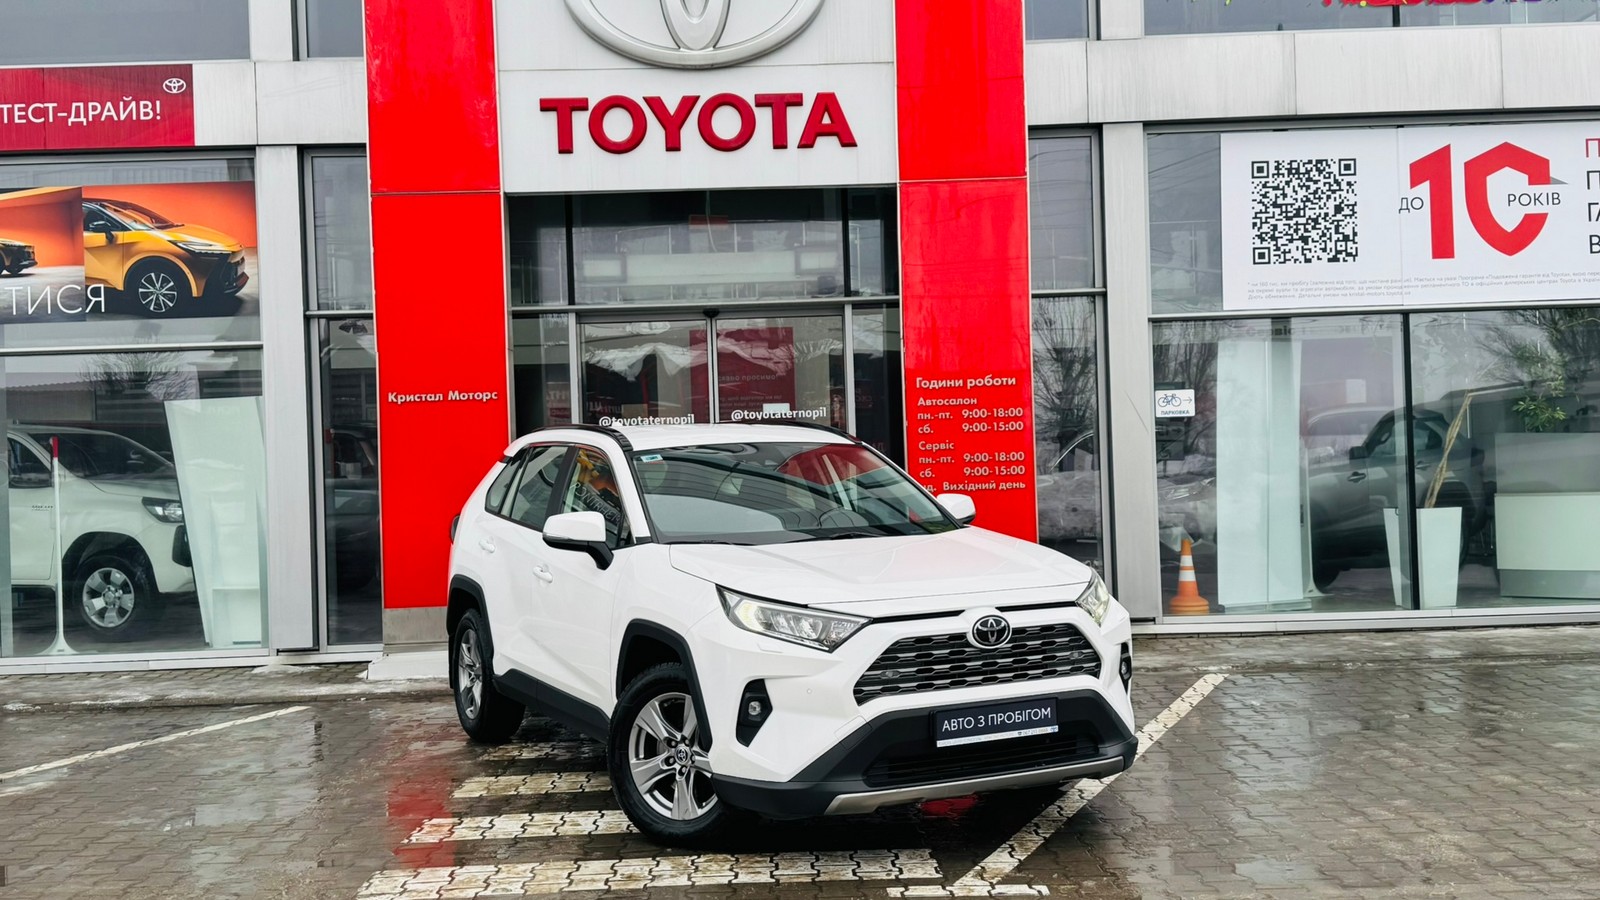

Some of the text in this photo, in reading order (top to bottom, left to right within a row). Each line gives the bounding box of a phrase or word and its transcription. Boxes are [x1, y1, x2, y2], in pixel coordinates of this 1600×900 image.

[0, 97, 162, 126] ТЕСТ-ДРАЙВ!
[539, 92, 858, 154] TOYOTA
[1399, 197, 1424, 214] ДО
[1507, 193, 1561, 207] РОКІВ
[916, 374, 1016, 389] Години роботи
[388, 390, 498, 404] Кристал Моторс
[918, 397, 978, 406] Автосалон
[731, 407, 827, 421] @toyotaternopil
[918, 408, 1024, 420] пн.-пт. 9:00-18:00
[918, 422, 1024, 434] сб. 9:00-15:00
[918, 440, 954, 452] Сервіс
[919, 452, 1025, 464] пн.-пт. 9:00-18:00
[920, 466, 1026, 478] сб. 9:00-15:00
[943, 480, 996, 491] Вихідний
[942, 716, 974, 732] АВТО
[988, 707, 1051, 726] ПРОБІГОМ
